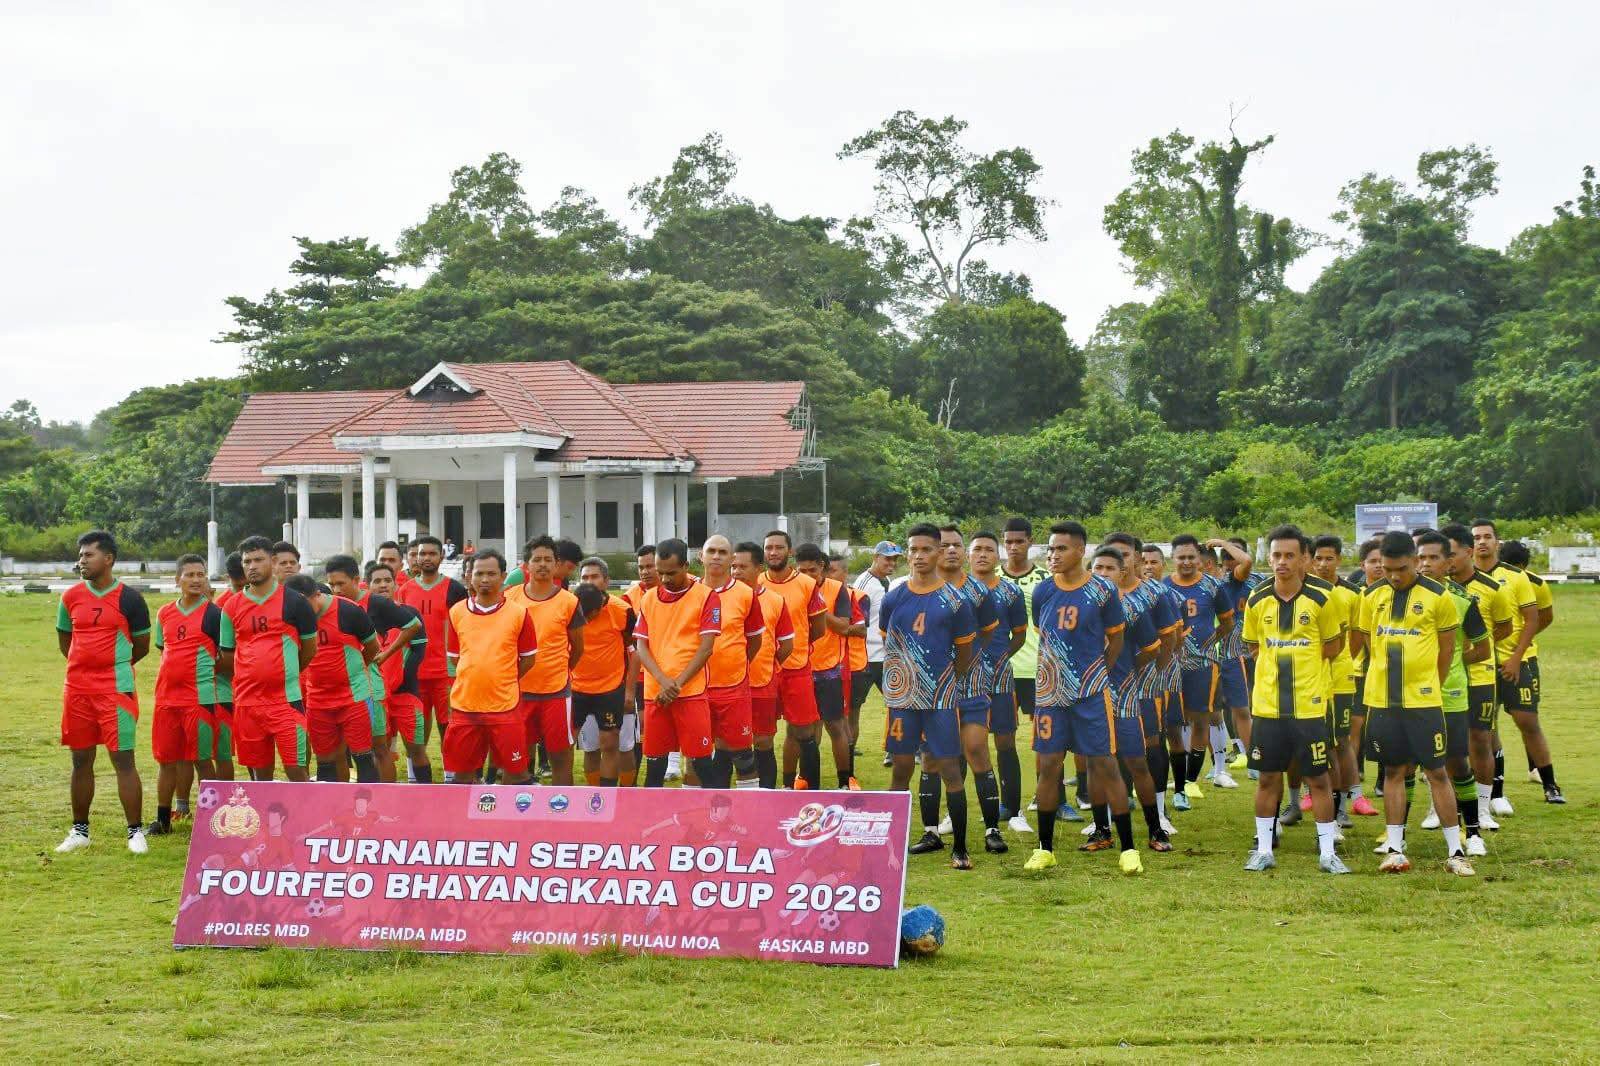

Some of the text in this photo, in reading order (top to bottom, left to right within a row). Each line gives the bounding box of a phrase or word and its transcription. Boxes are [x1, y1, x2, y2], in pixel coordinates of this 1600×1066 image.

[421, 599, 432, 614] 11
[1186, 598, 1197, 617] 5
[91, 608, 102, 625] 7
[252, 615, 269, 633] 18
[912, 612, 926, 636] 4
[1057, 605, 1079, 631] 13
[176, 625, 187, 640] 8
[1519, 687, 1531, 701] 10
[1481, 702, 1493, 717] 17
[890, 717, 904, 740] 4
[1311, 741, 1327, 760] 12
[1434, 733, 1443, 751] 8
[305, 838, 776, 875] TURNAMEN SEPAK BOLA
[199, 869, 882, 914] FOURFEO BHAYANGKARA CUP 2026
[204, 922, 310, 938] #POLRES MBD
[360, 926, 467, 943] #PEMDA MBD
[511, 930, 721, 950] #KODIM 1511 PULAU MOA
[758, 937, 870, 956] #ASKAB MBD
